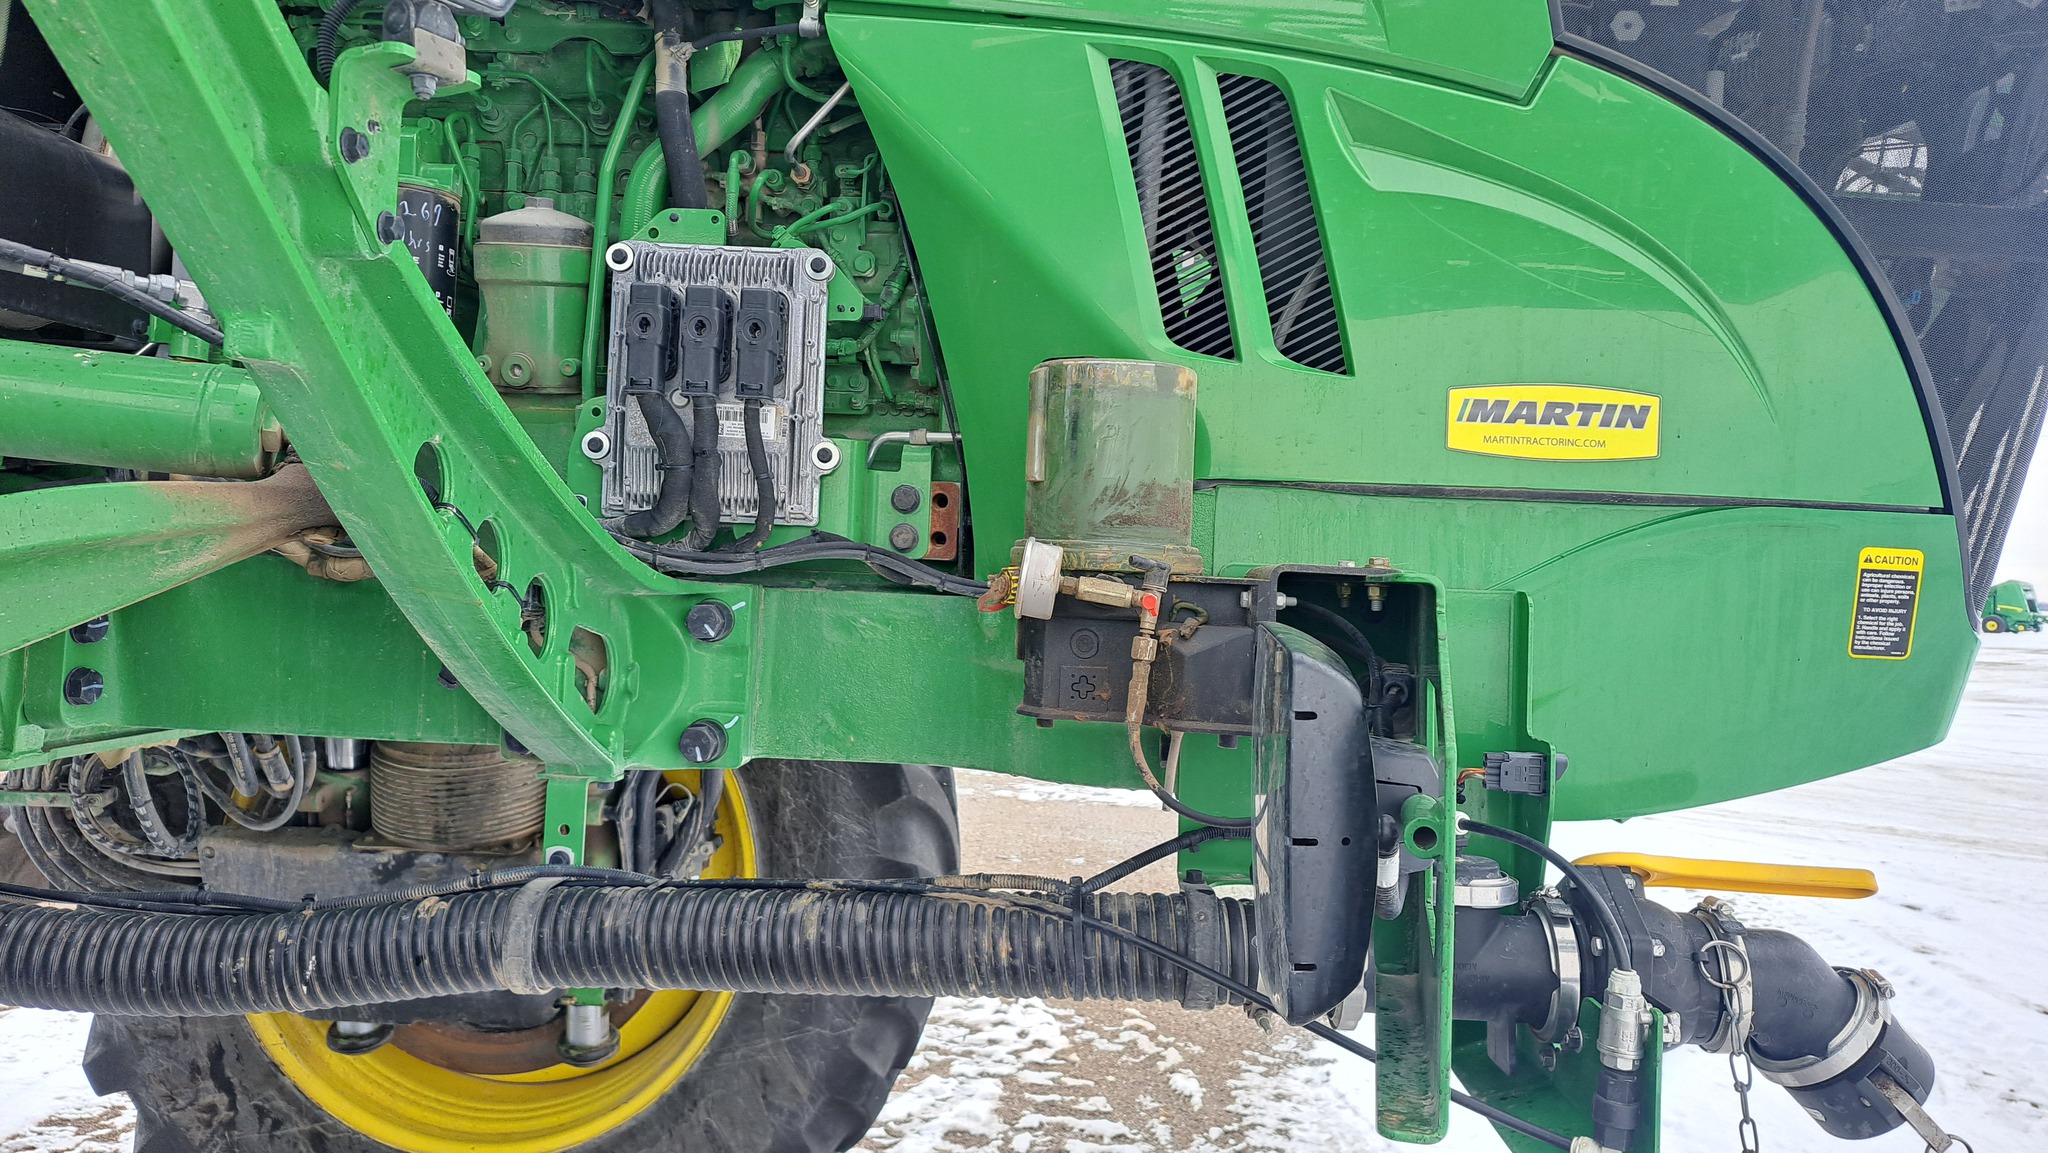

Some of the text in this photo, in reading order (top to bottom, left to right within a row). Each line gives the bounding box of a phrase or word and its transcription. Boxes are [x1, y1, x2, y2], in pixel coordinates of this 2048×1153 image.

[1465, 398, 1652, 430] MARTIN
[1483, 435, 1606, 448] MARTINTRACTORINC.COM
[1875, 555, 1918, 566] CAUTION
